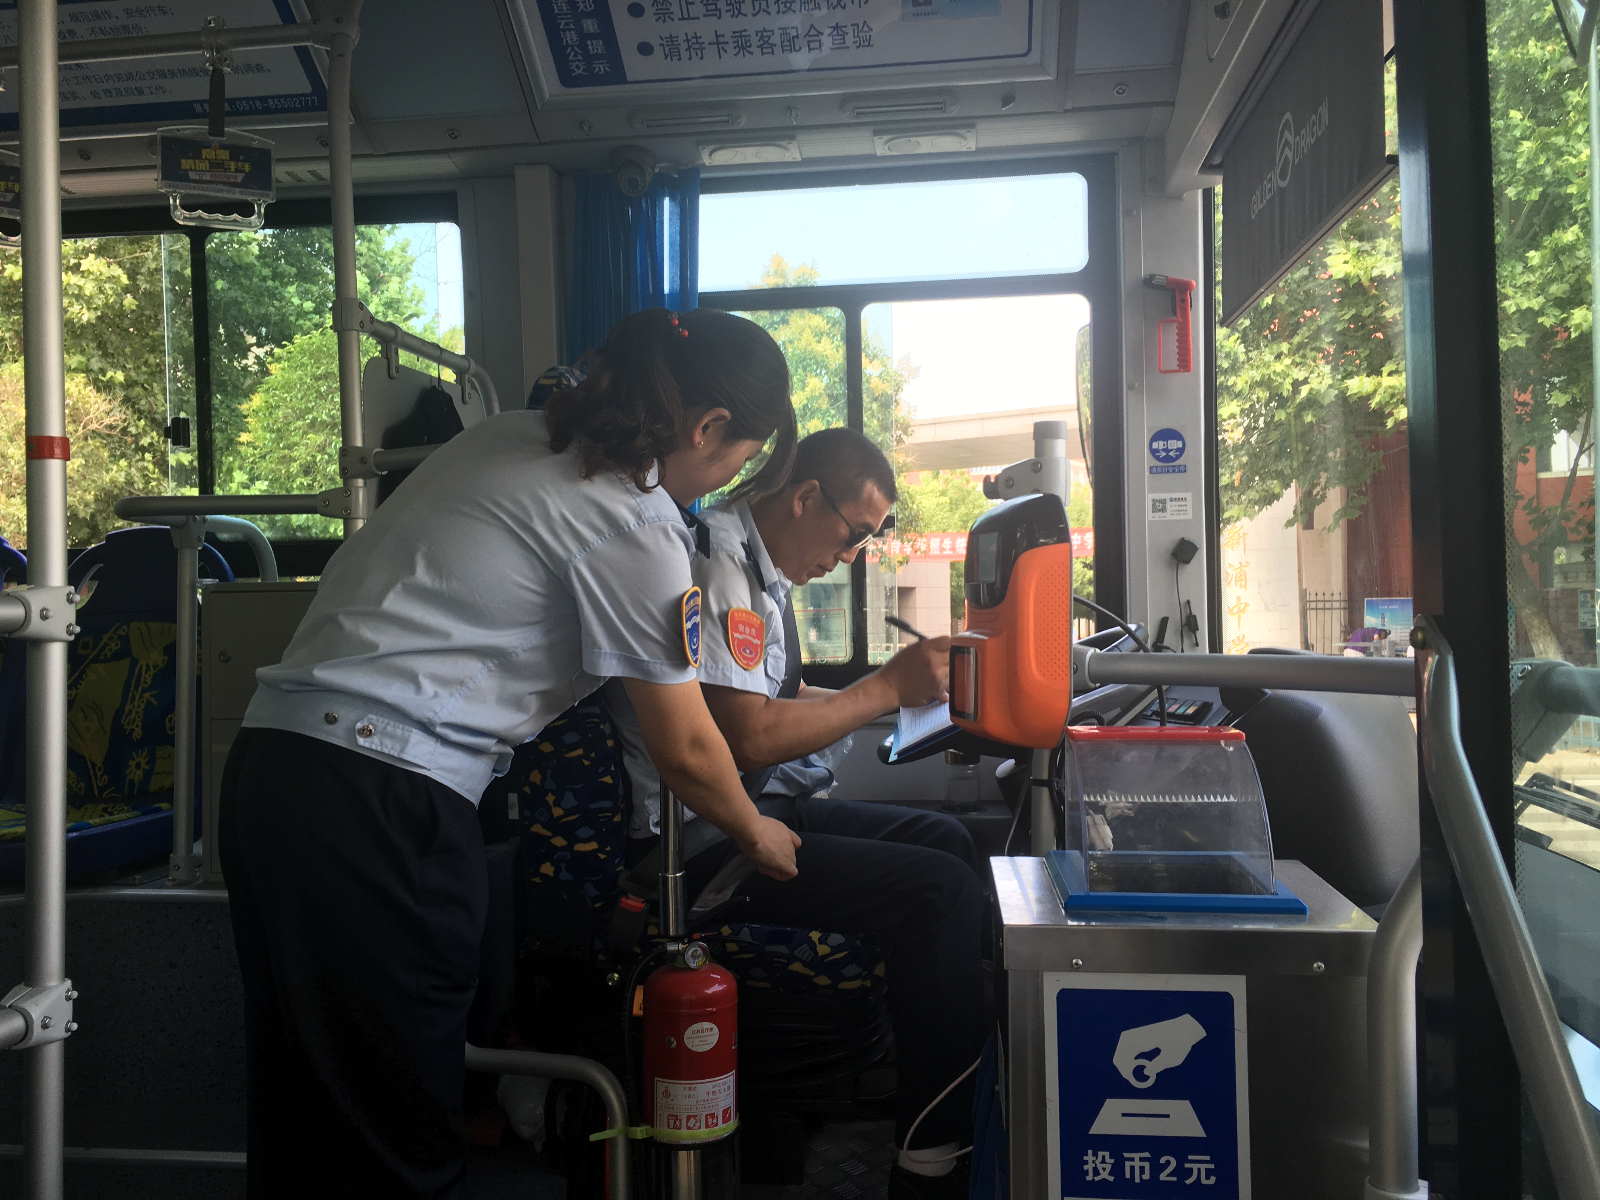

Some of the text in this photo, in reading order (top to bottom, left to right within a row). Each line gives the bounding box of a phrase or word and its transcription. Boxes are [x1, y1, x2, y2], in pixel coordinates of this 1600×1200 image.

[658, 20, 874, 62] 请持卡乘客配合查验
[1250, 97, 1329, 220] GOLDEN DRAGON
[1221, 523, 1250, 655] 新浦中学
[1083, 1149, 1217, 1186] 投币2元
